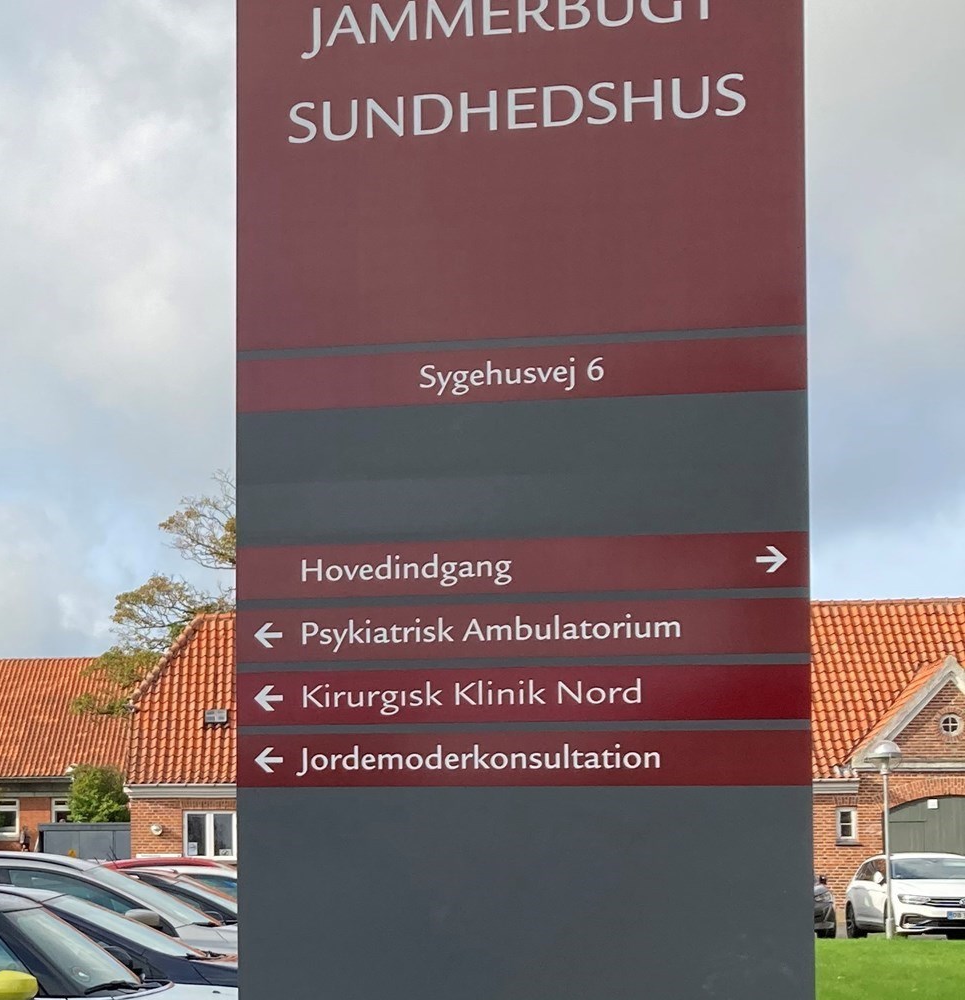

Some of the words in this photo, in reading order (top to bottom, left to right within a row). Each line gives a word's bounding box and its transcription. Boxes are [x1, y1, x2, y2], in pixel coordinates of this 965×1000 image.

[288, 73, 746, 144] SUNDHEDSHUS
[419, 357, 576, 396] Sygehusvej
[586, 356, 604, 381] 6
[301, 553, 513, 587] Hovedindgang
[301, 617, 454, 653] Psykiatrisk
[462, 613, 682, 642] Ambulatorium
[455, 679, 546, 706] Klinik
[557, 677, 642, 705] Nord
[296, 743, 661, 777] Jordemoderkonsultation
